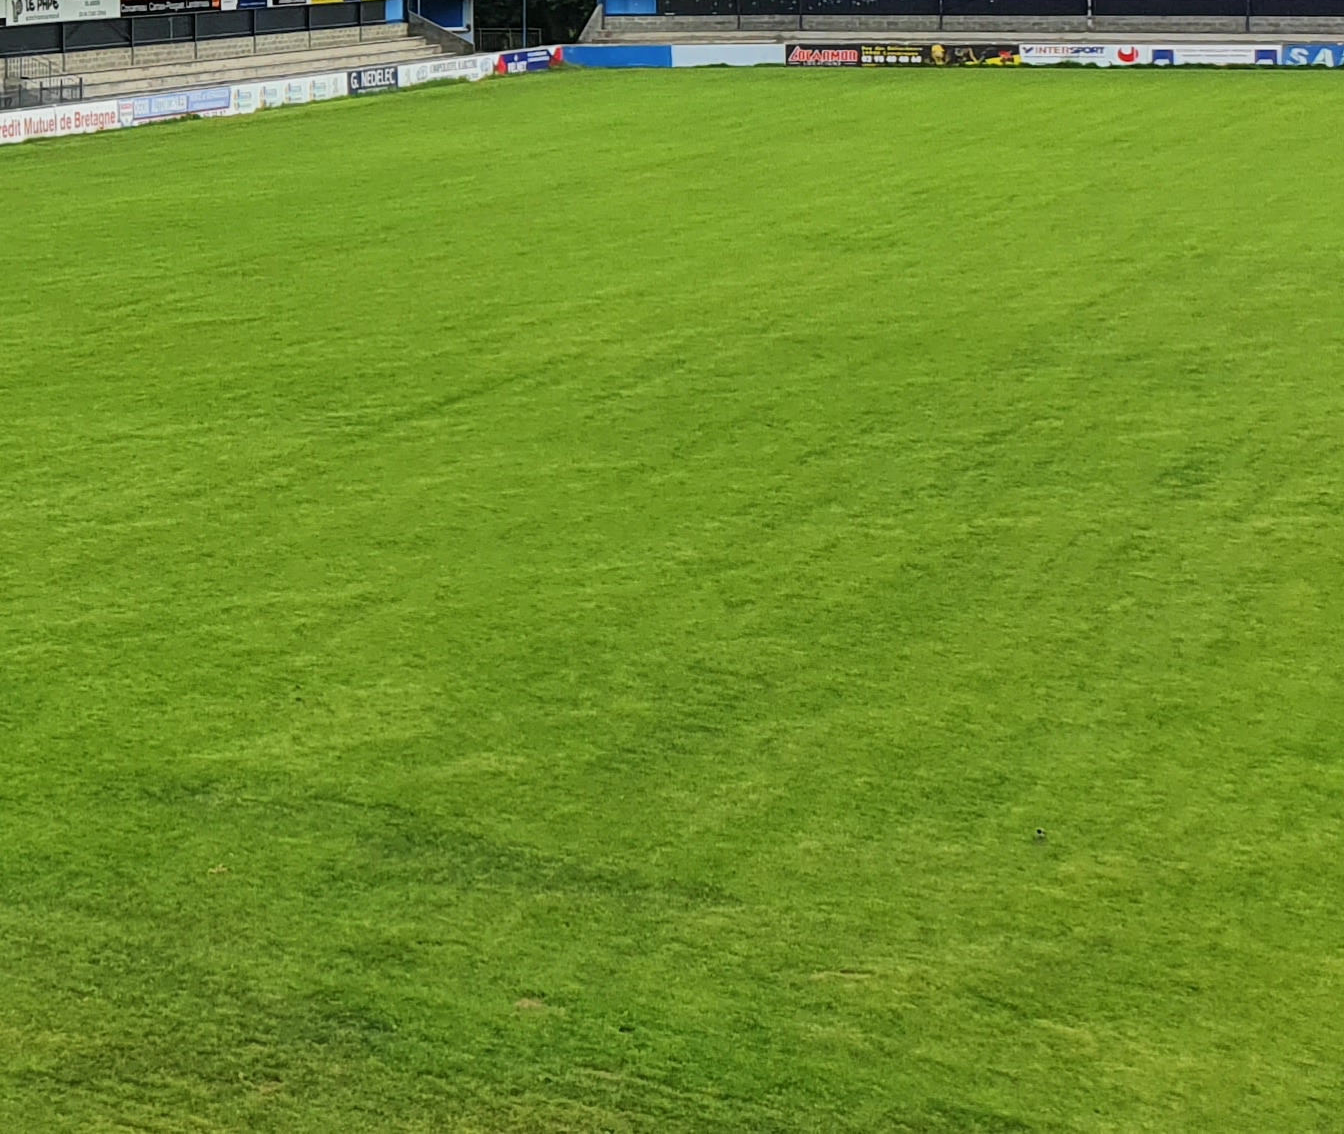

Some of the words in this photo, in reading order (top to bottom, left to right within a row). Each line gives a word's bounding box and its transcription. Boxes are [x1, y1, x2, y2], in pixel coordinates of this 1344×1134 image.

[1035, 46, 1106, 54] INTERSPORT
[361, 68, 395, 87] NEDELEC
[24, 114, 57, 135] Mutuel
[60, 113, 71, 130] de
[74, 111, 116, 129] Bretagne
